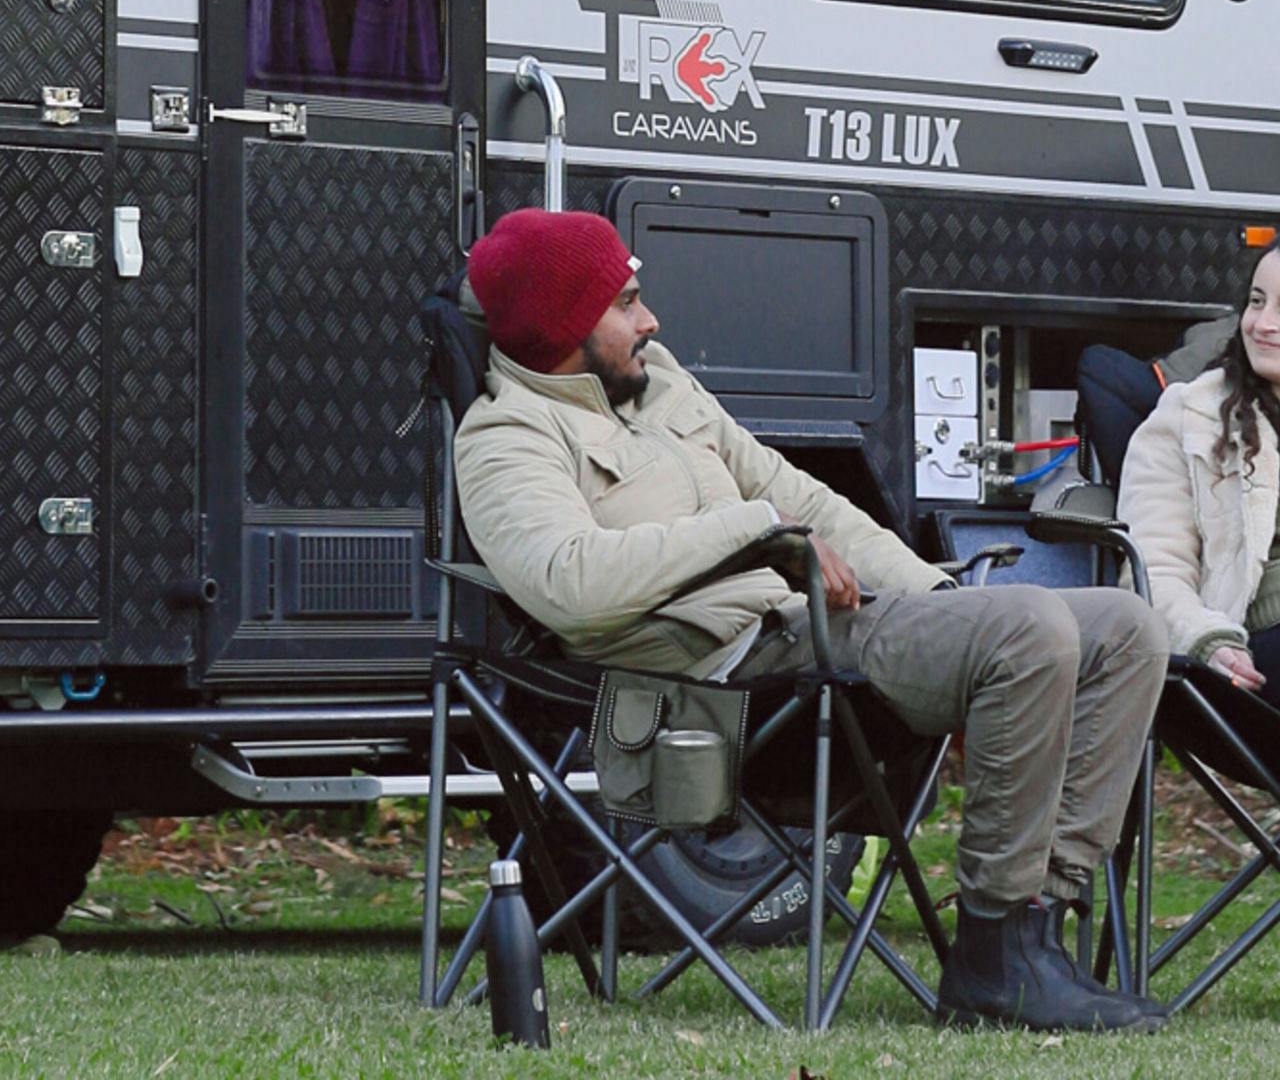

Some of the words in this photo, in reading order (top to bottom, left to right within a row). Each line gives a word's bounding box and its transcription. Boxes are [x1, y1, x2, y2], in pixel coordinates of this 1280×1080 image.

[613, 111, 758, 146] CARAVANS
[804, 107, 872, 162] T13
[881, 112, 961, 168] LUX
